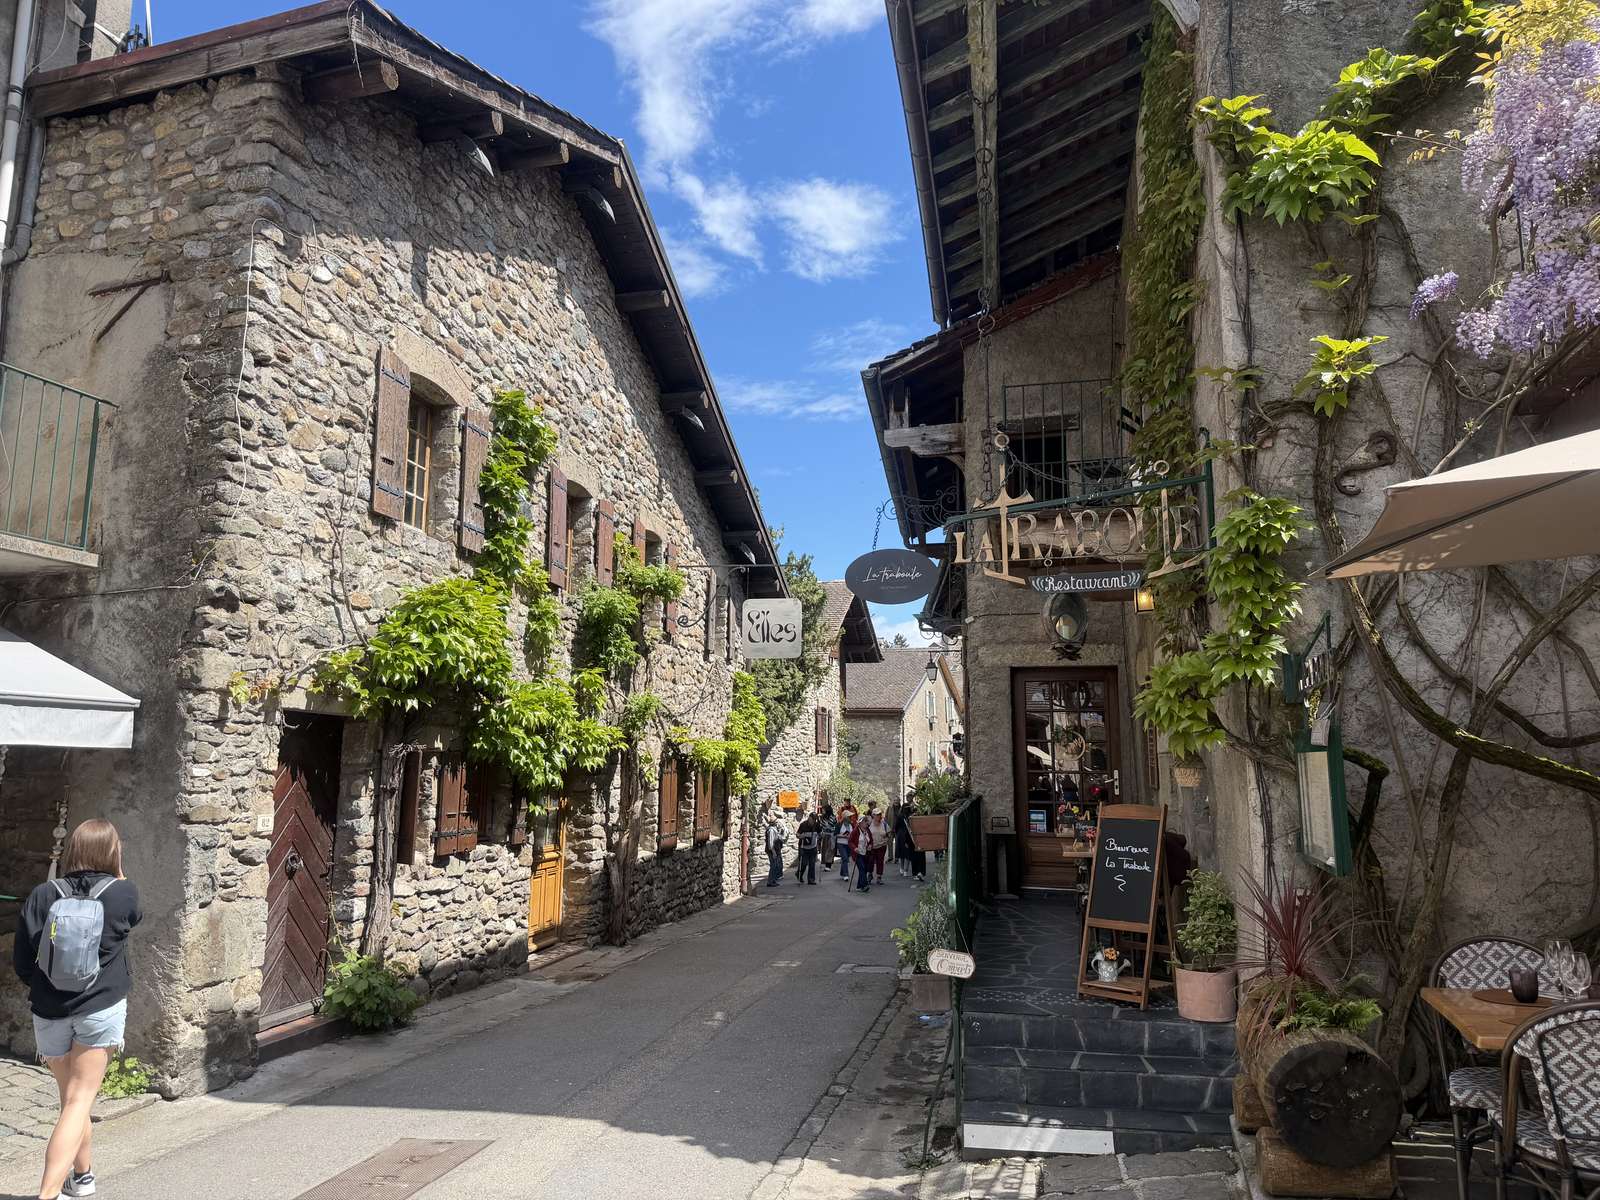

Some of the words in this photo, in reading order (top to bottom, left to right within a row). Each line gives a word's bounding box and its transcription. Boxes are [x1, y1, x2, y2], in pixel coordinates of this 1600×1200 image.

[953, 530, 994, 563] LA
[862, 566, 879, 583] La
[1045, 575, 1127, 592] Restaurant
